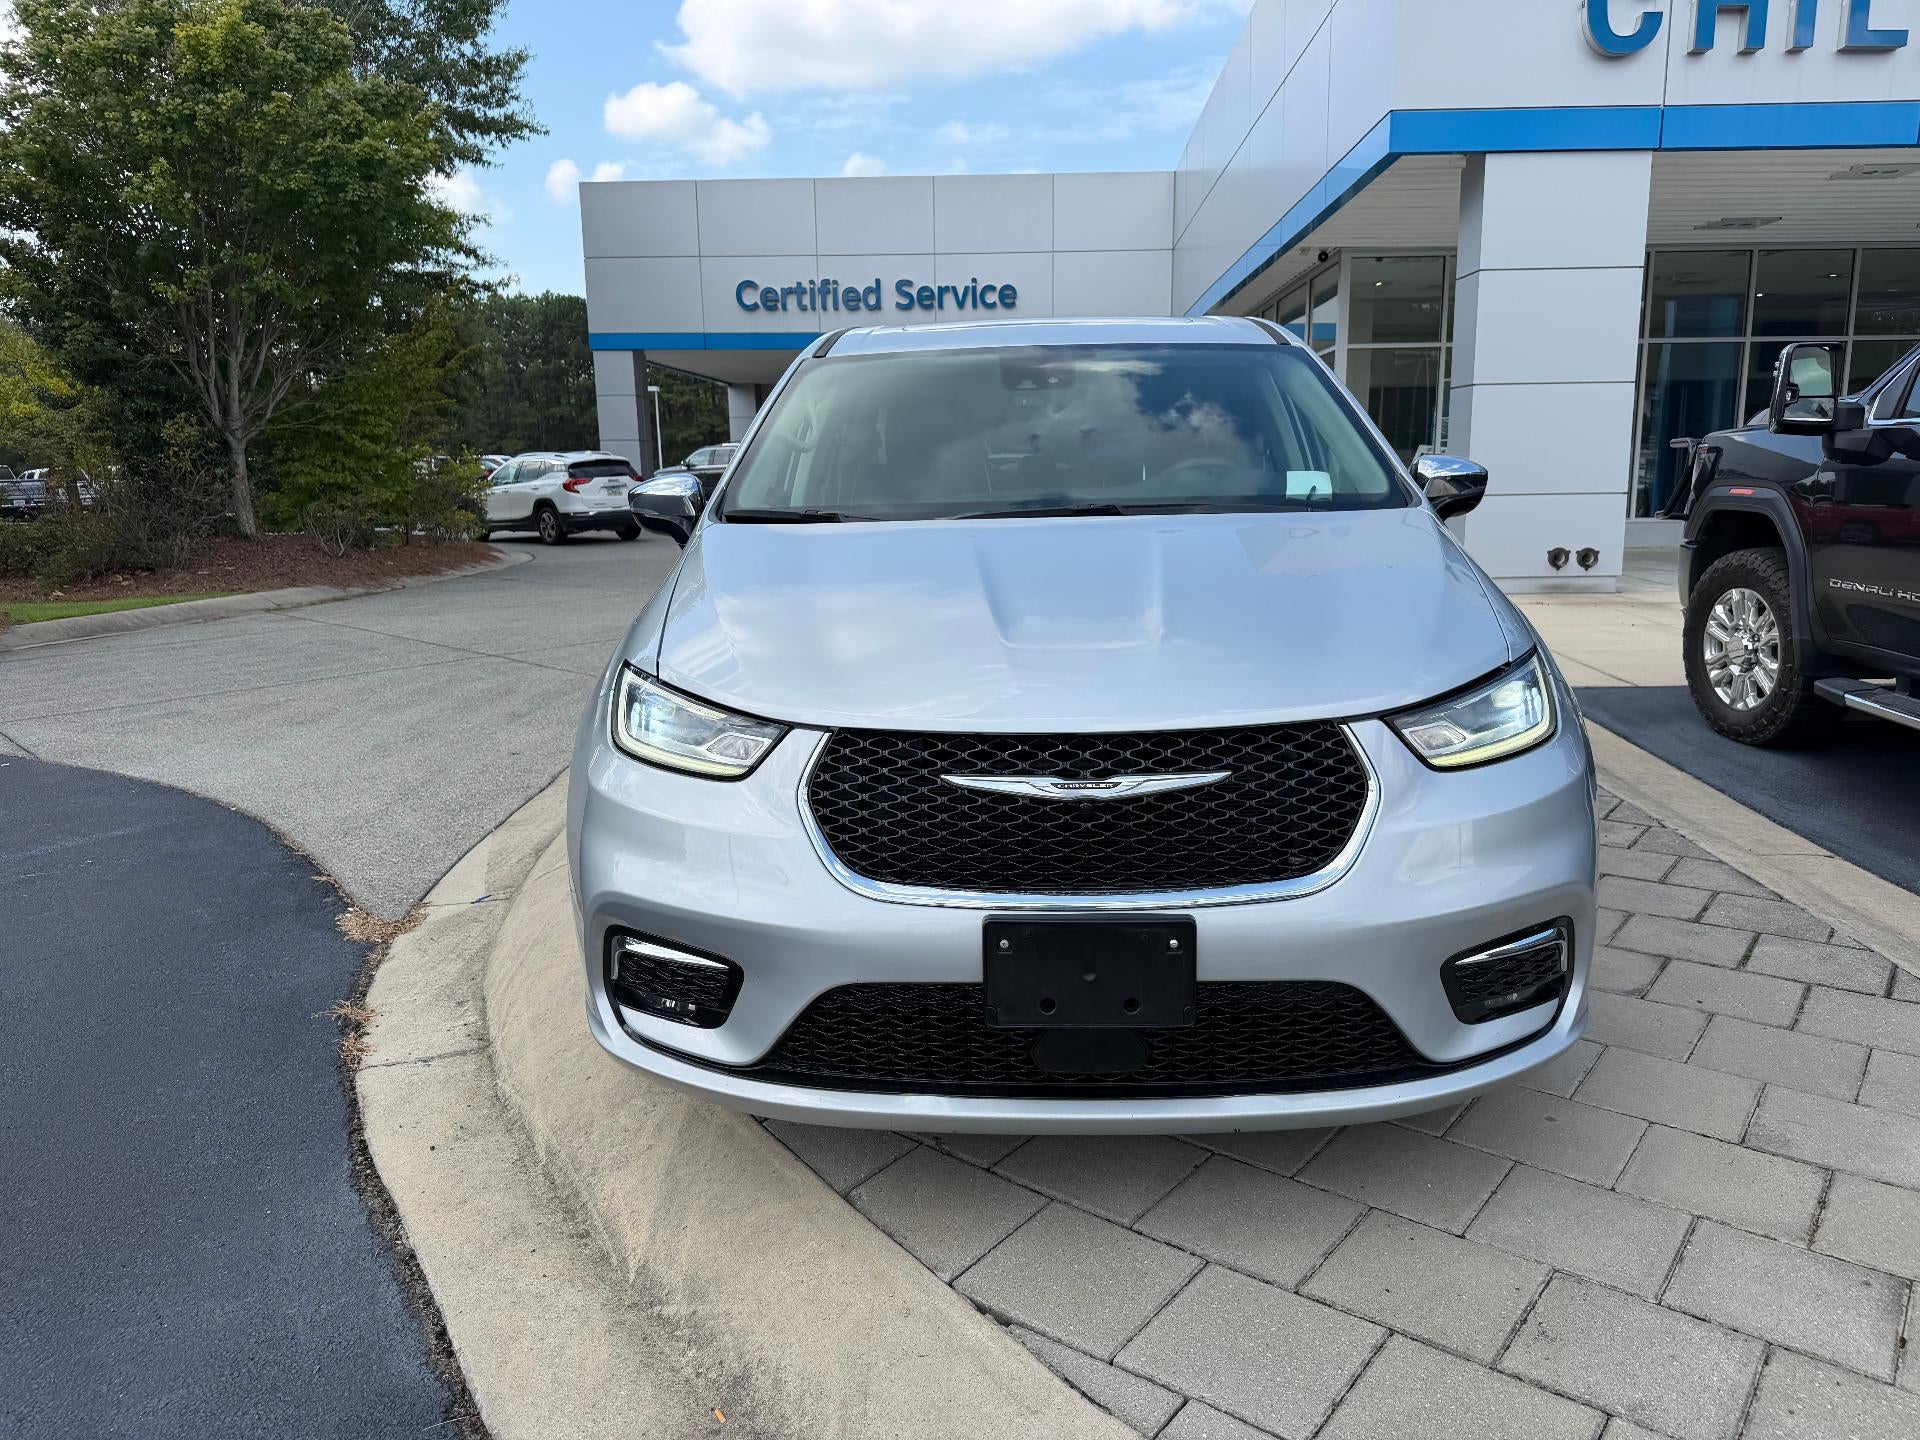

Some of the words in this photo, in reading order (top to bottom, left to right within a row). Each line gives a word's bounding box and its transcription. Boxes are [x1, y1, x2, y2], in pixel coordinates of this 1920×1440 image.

[736, 279, 881, 311] Certified
[895, 278, 1018, 310] Service
[1829, 578, 1894, 597] DENALI
